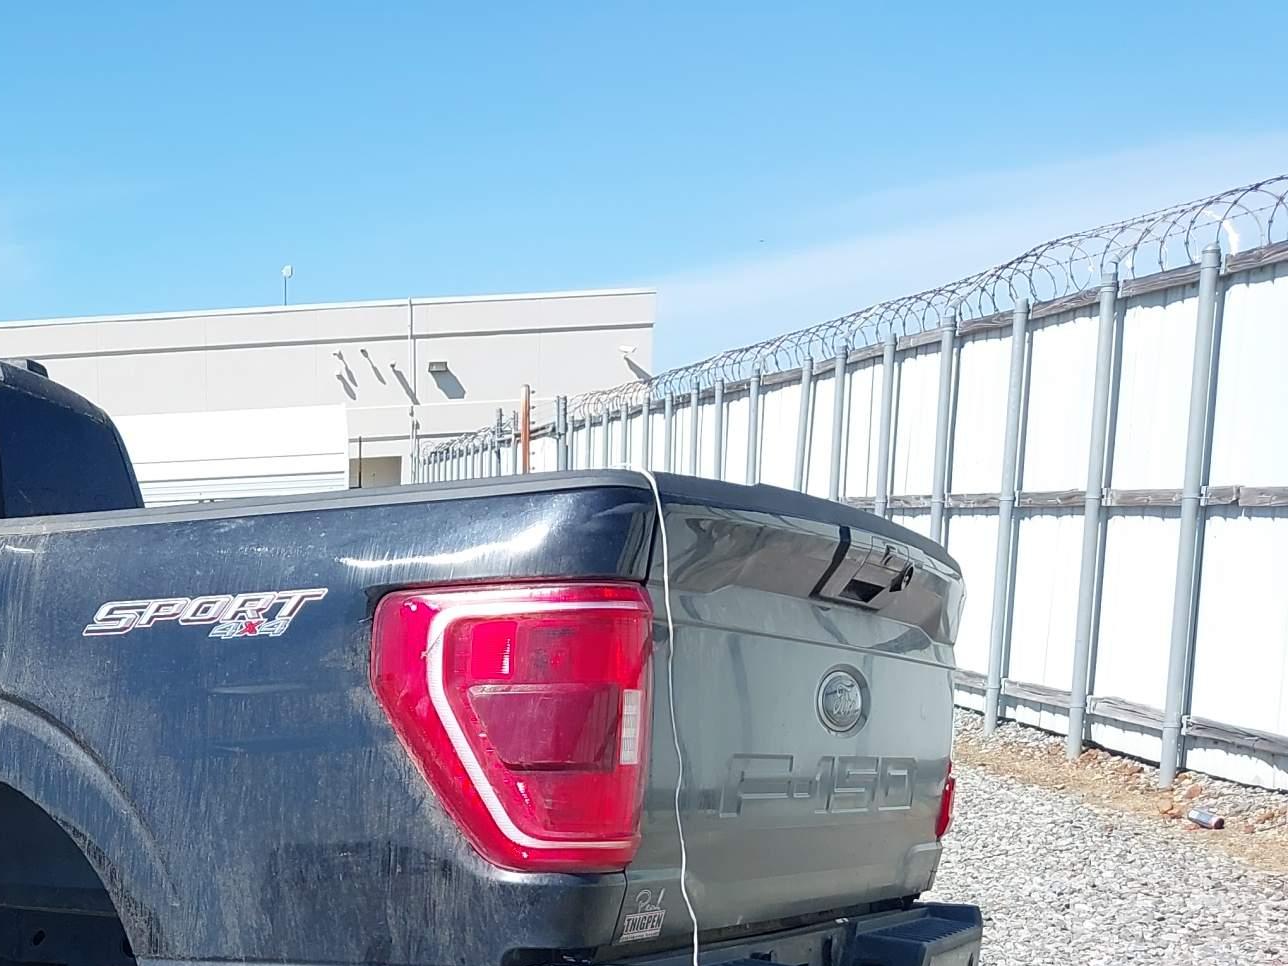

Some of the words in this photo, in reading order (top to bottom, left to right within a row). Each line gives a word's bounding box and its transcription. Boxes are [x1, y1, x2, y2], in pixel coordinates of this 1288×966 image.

[82, 588, 329, 636] SPORT
[720, 754, 916, 818] F-150
[623, 912, 664, 934] THIGPEN
